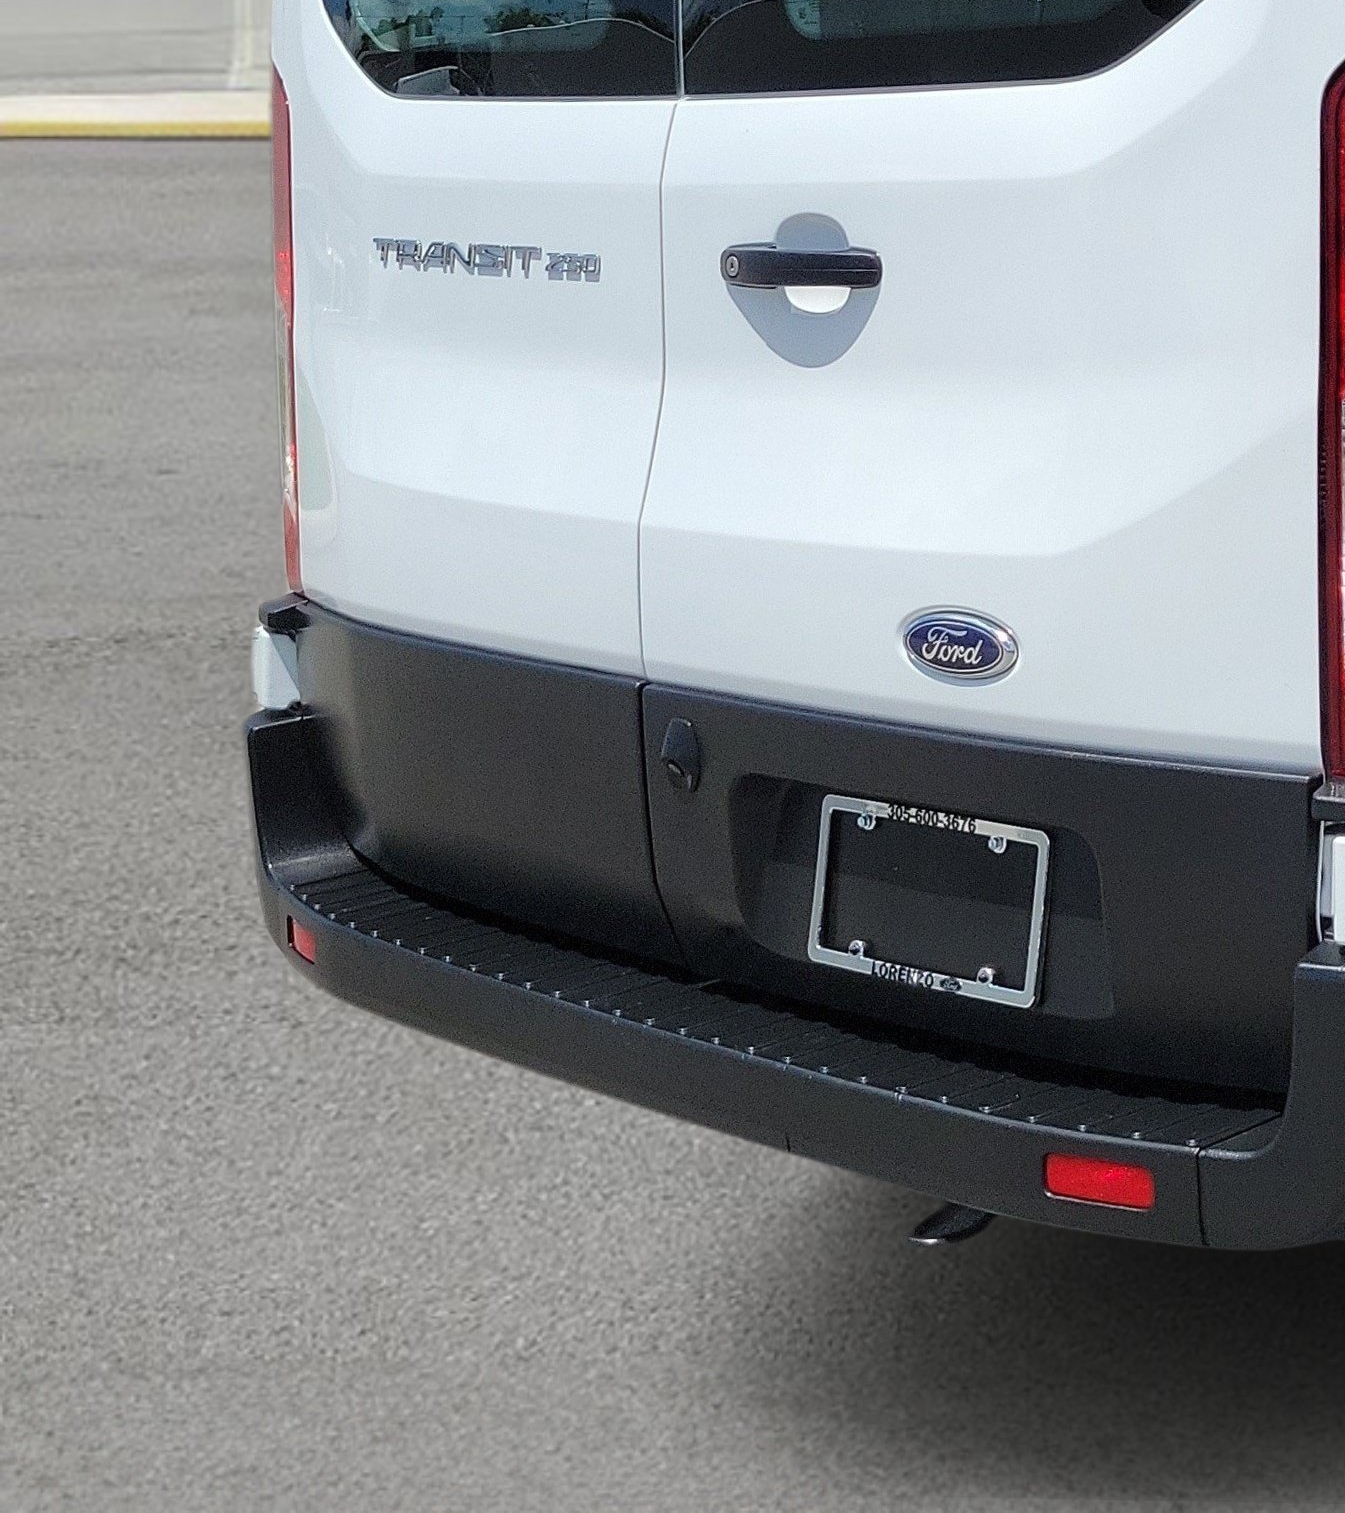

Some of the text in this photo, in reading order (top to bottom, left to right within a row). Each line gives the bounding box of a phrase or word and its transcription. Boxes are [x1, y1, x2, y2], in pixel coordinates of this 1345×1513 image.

[372, 237, 542, 279] TRANSIT
[922, 626, 984, 665] Ford
[887, 804, 976, 834] 305-600-3676
[871, 961, 934, 988] LORENZO
